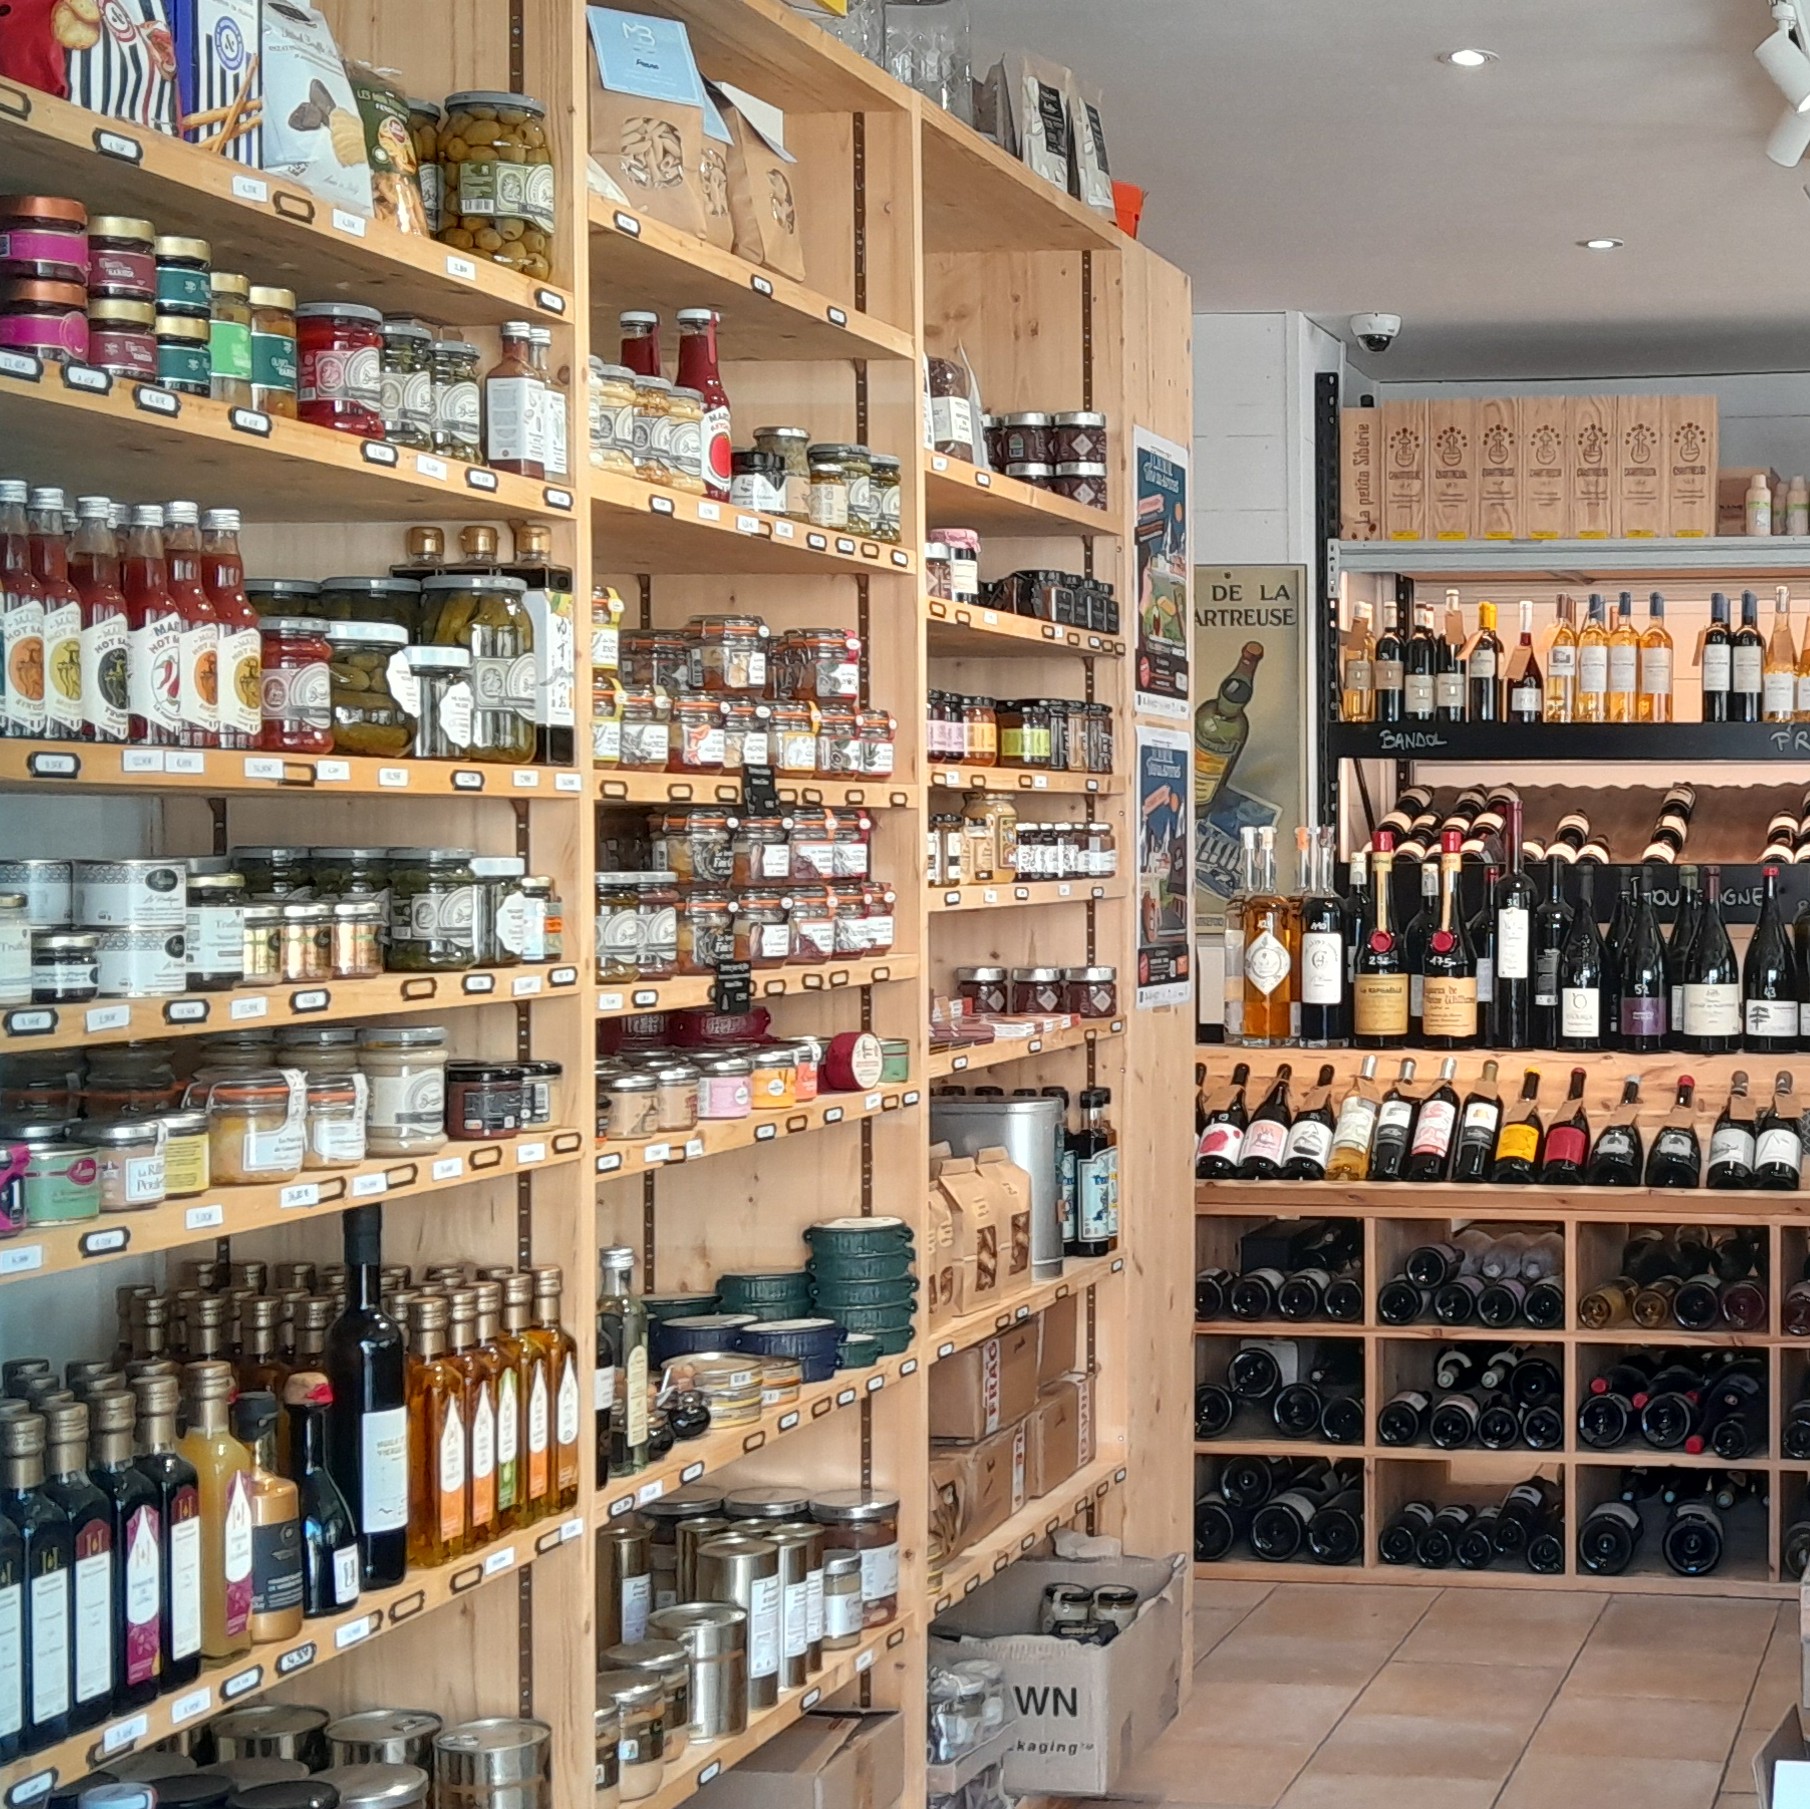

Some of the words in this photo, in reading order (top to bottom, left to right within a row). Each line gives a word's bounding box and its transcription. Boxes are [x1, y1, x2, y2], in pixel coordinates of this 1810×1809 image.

[1211, 585, 1243, 601] DE
[1260, 585, 1290, 601] LA
[1379, 729, 1447, 750] BANDOL
[1634, 984, 1650, 995] 52
[1764, 987, 1777, 998] 43
[1014, 1686, 1078, 1717] WN
